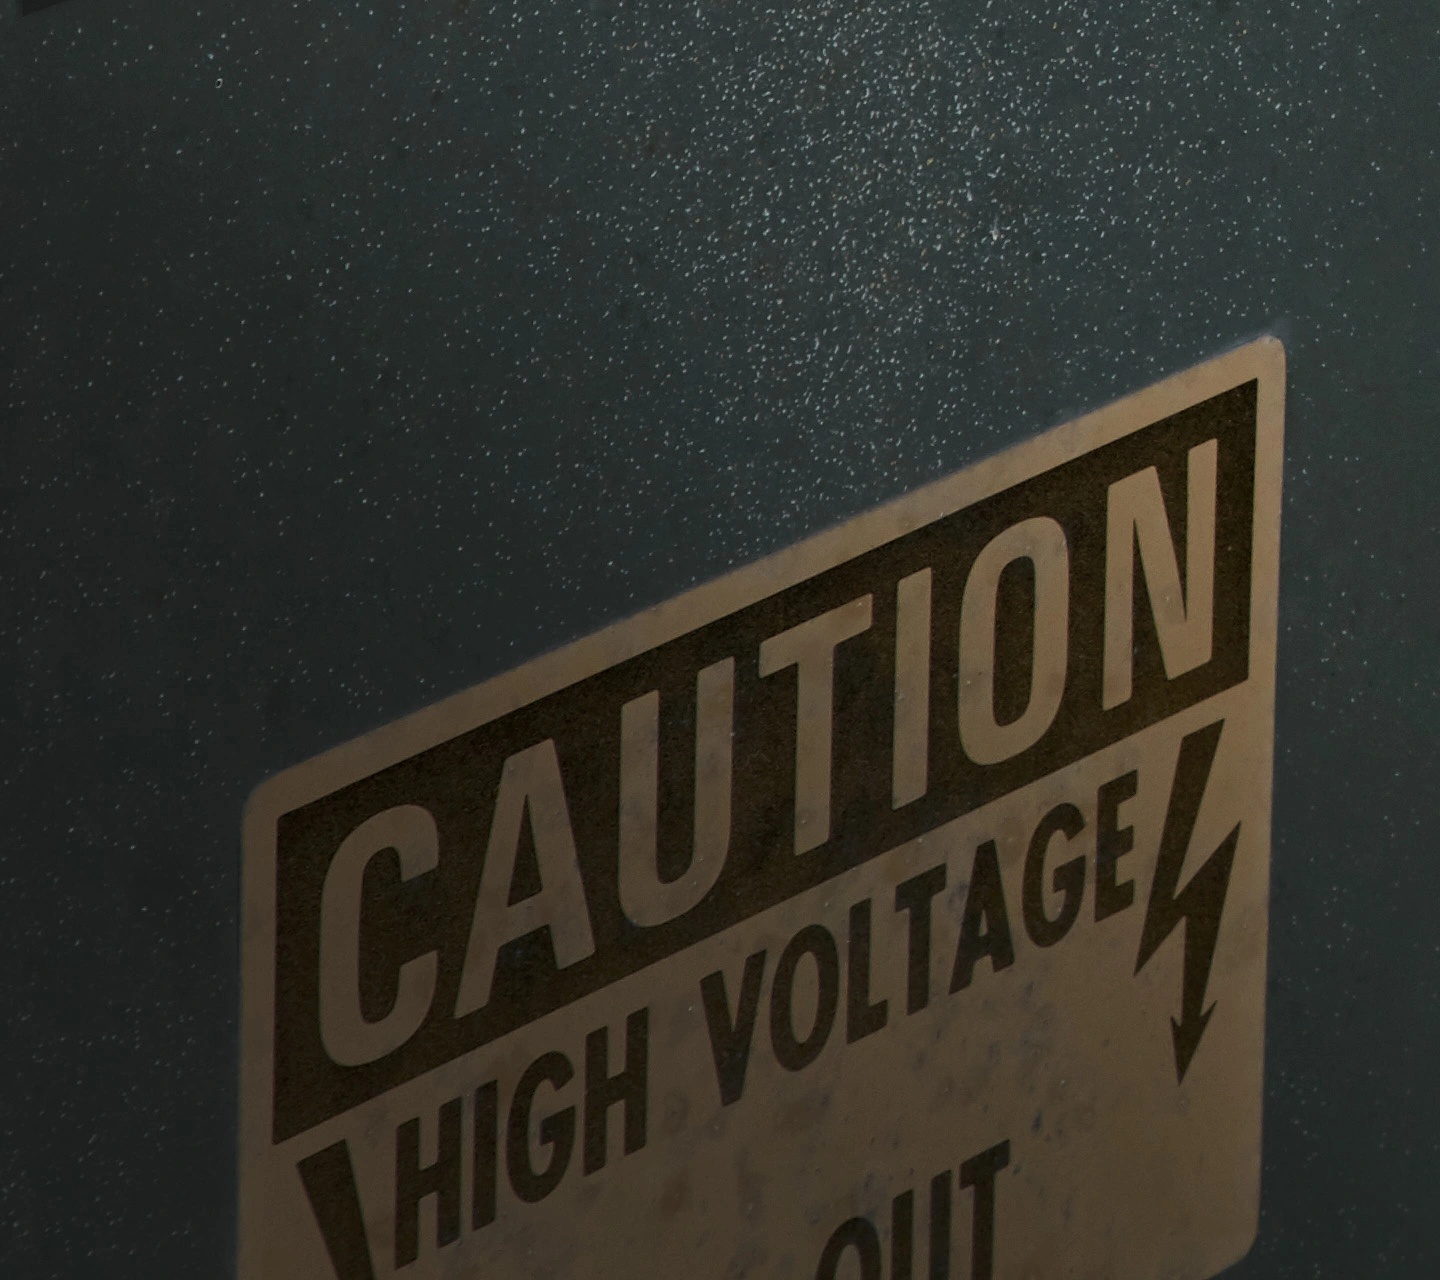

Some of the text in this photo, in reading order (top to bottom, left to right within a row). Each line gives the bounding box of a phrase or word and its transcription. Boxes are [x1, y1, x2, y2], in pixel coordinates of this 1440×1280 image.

[318, 438, 1219, 1068] CAUTION
[394, 768, 1139, 1270] HIGH VOLTAGE
